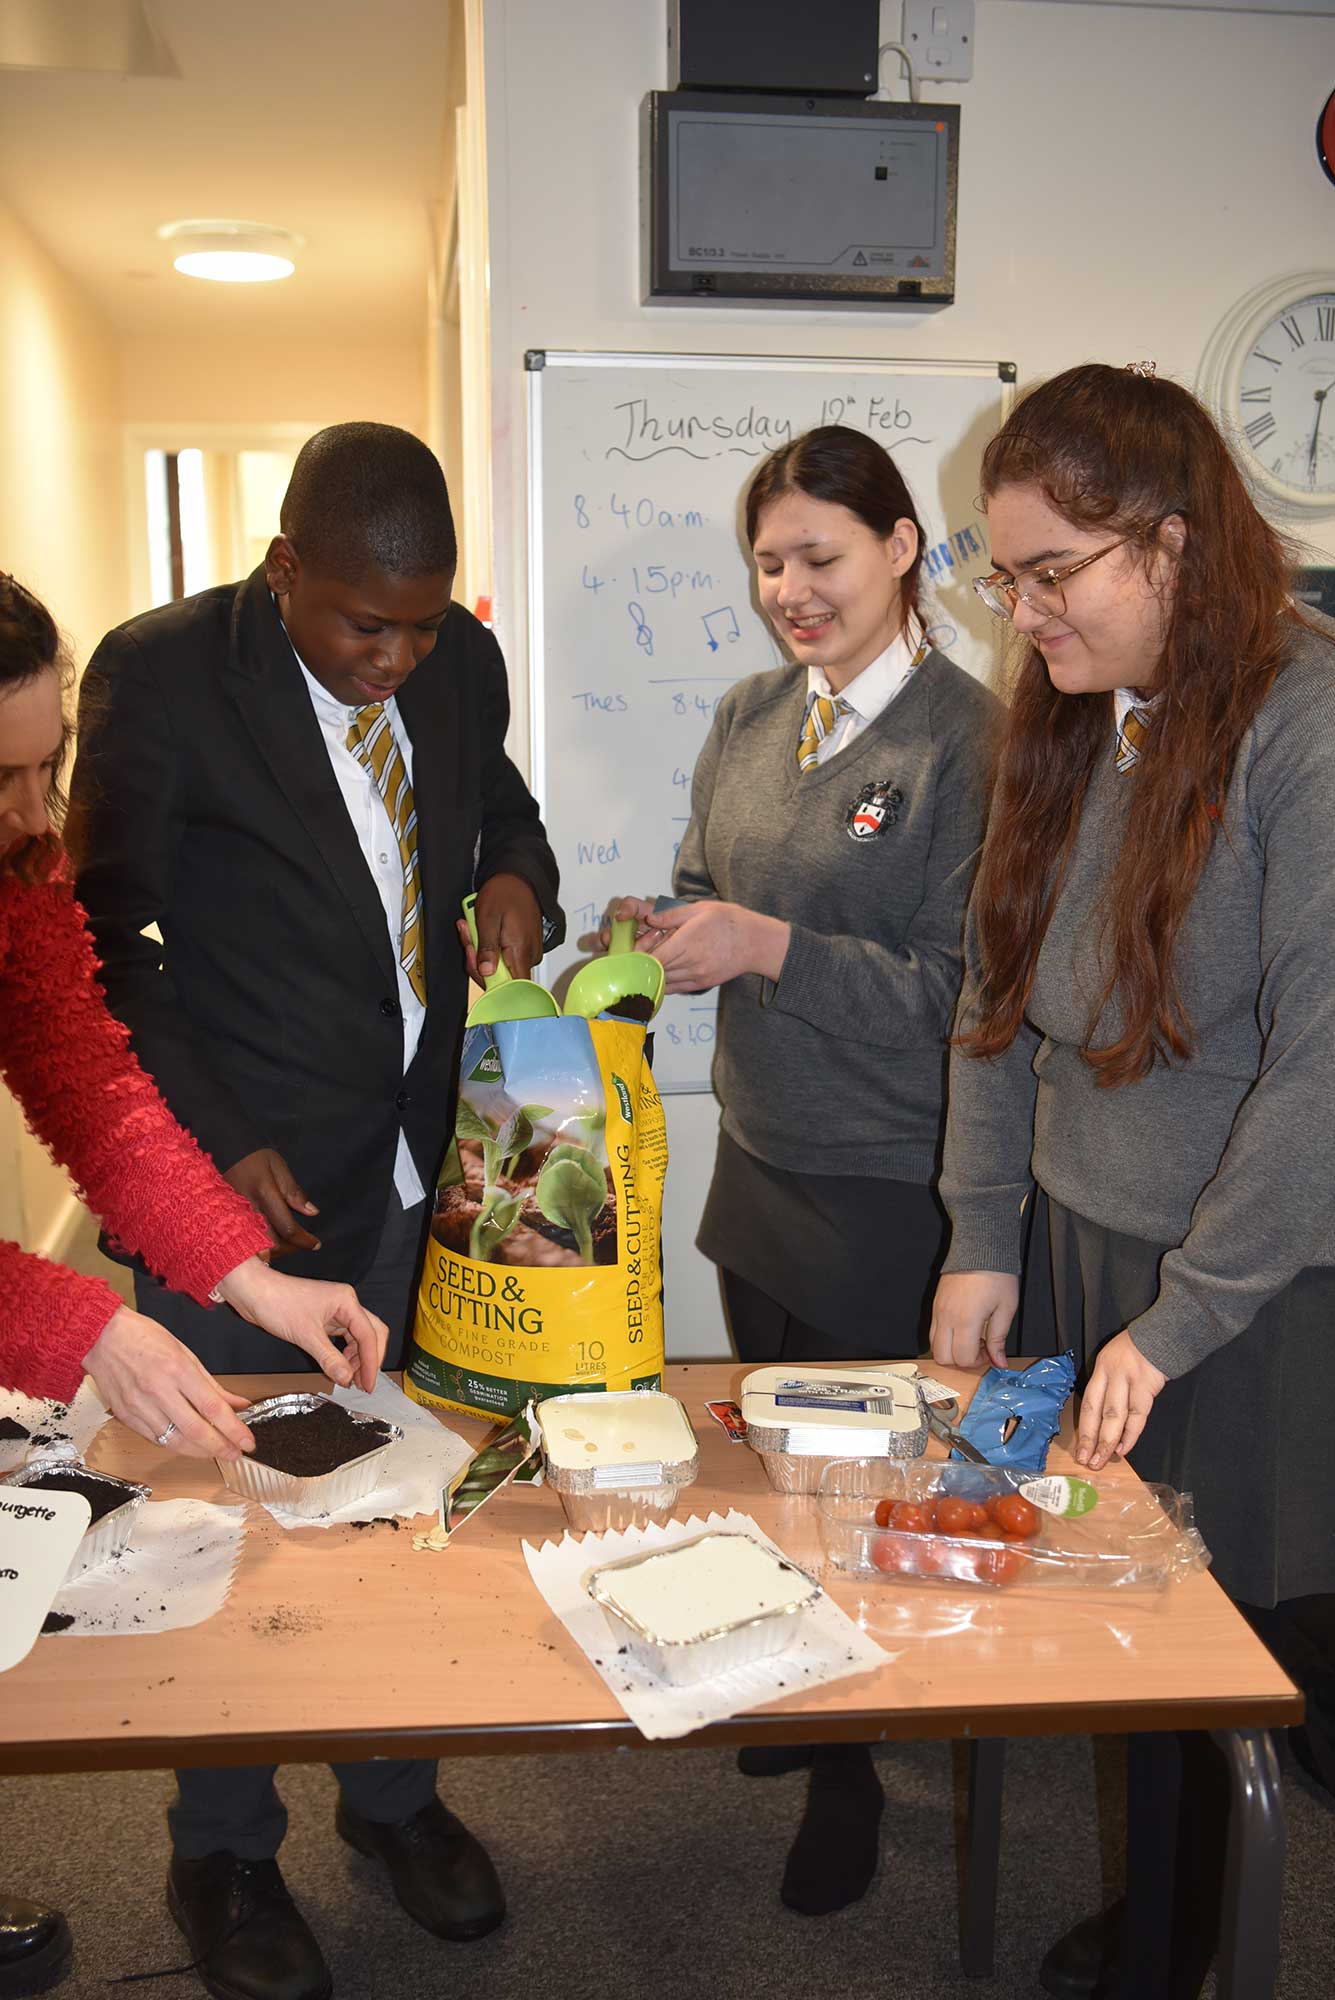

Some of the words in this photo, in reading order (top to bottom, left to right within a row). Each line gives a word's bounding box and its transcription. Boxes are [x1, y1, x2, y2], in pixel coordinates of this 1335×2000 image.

[613, 398, 792, 448] Thursday
[867, 397, 912, 429] Feb
[577, 838, 621, 865] Wed
[616, 1144, 642, 1256] CUTTING
[437, 1255, 497, 1298] SEED
[501, 1275, 526, 1303] &
[626, 1257, 642, 1276] &
[429, 1281, 544, 1335] CUTTING
[627, 1279, 644, 1345] SEED
[440, 1334, 515, 1367] COMPOST
[458, 1327, 488, 1345] FINE
[496, 1337, 550, 1353] GRADE
[576, 1340, 605, 1361] 10
[575, 1361, 607, 1371] LITRES
[467, 1378, 485, 1391] 25%
[485, 1386, 508, 1396] BETTER
[468, 1388, 508, 1402] GERMINATION
